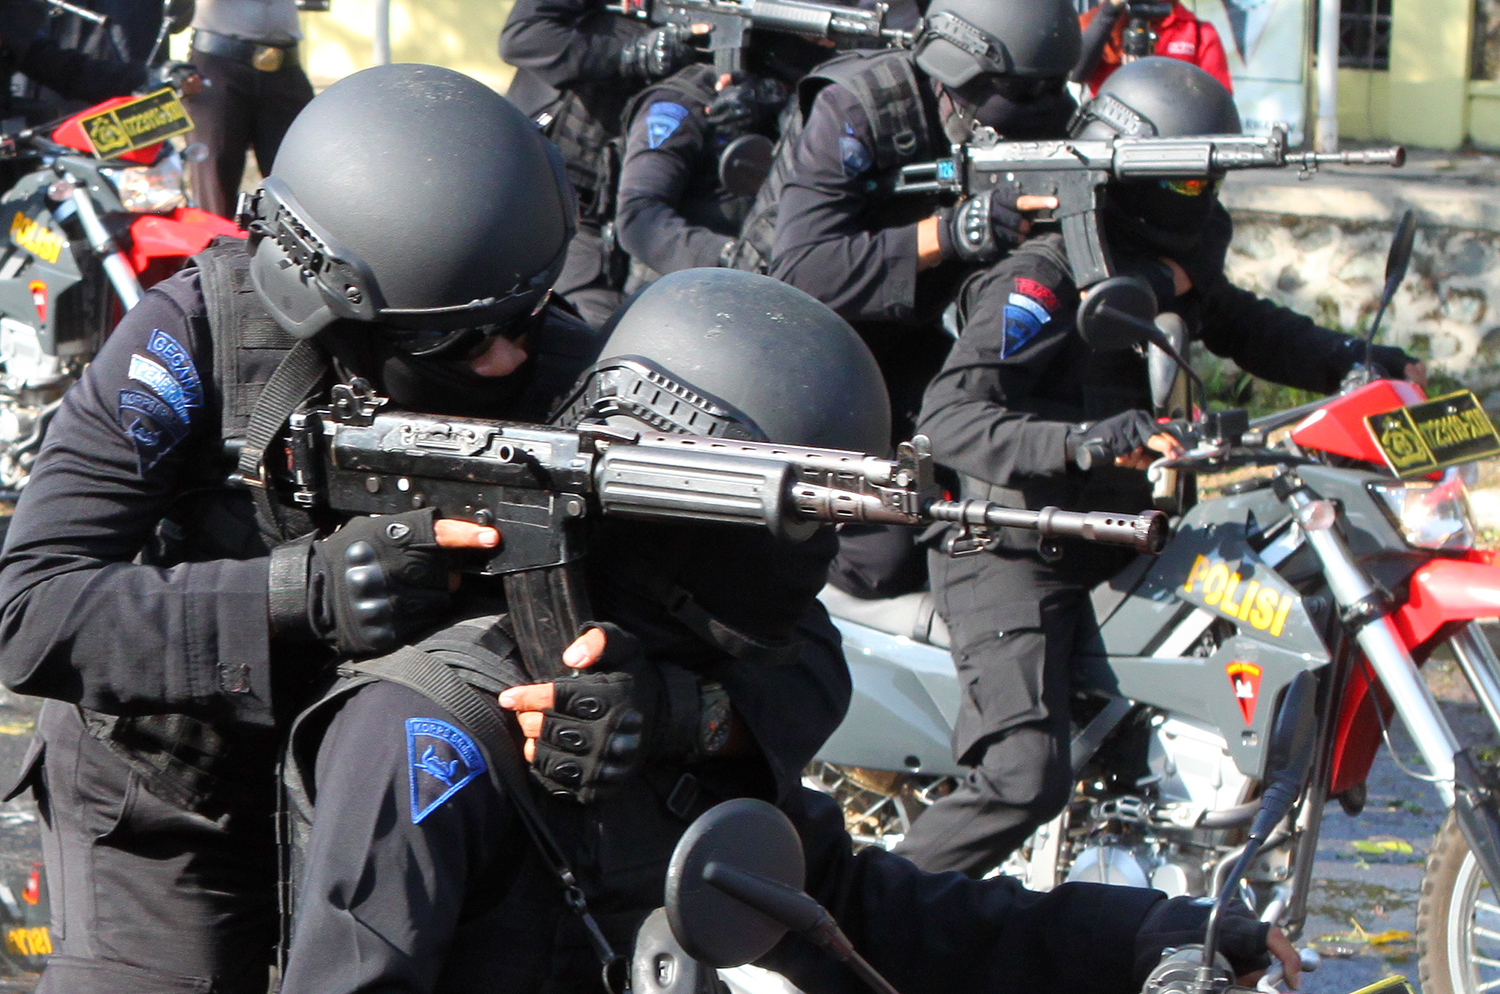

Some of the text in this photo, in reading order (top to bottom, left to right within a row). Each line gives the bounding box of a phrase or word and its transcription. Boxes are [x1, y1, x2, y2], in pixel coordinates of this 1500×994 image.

[10, 211, 64, 264] POLISI
[153, 337, 202, 408] GEGANA
[1183, 554, 1293, 637] POLISI
